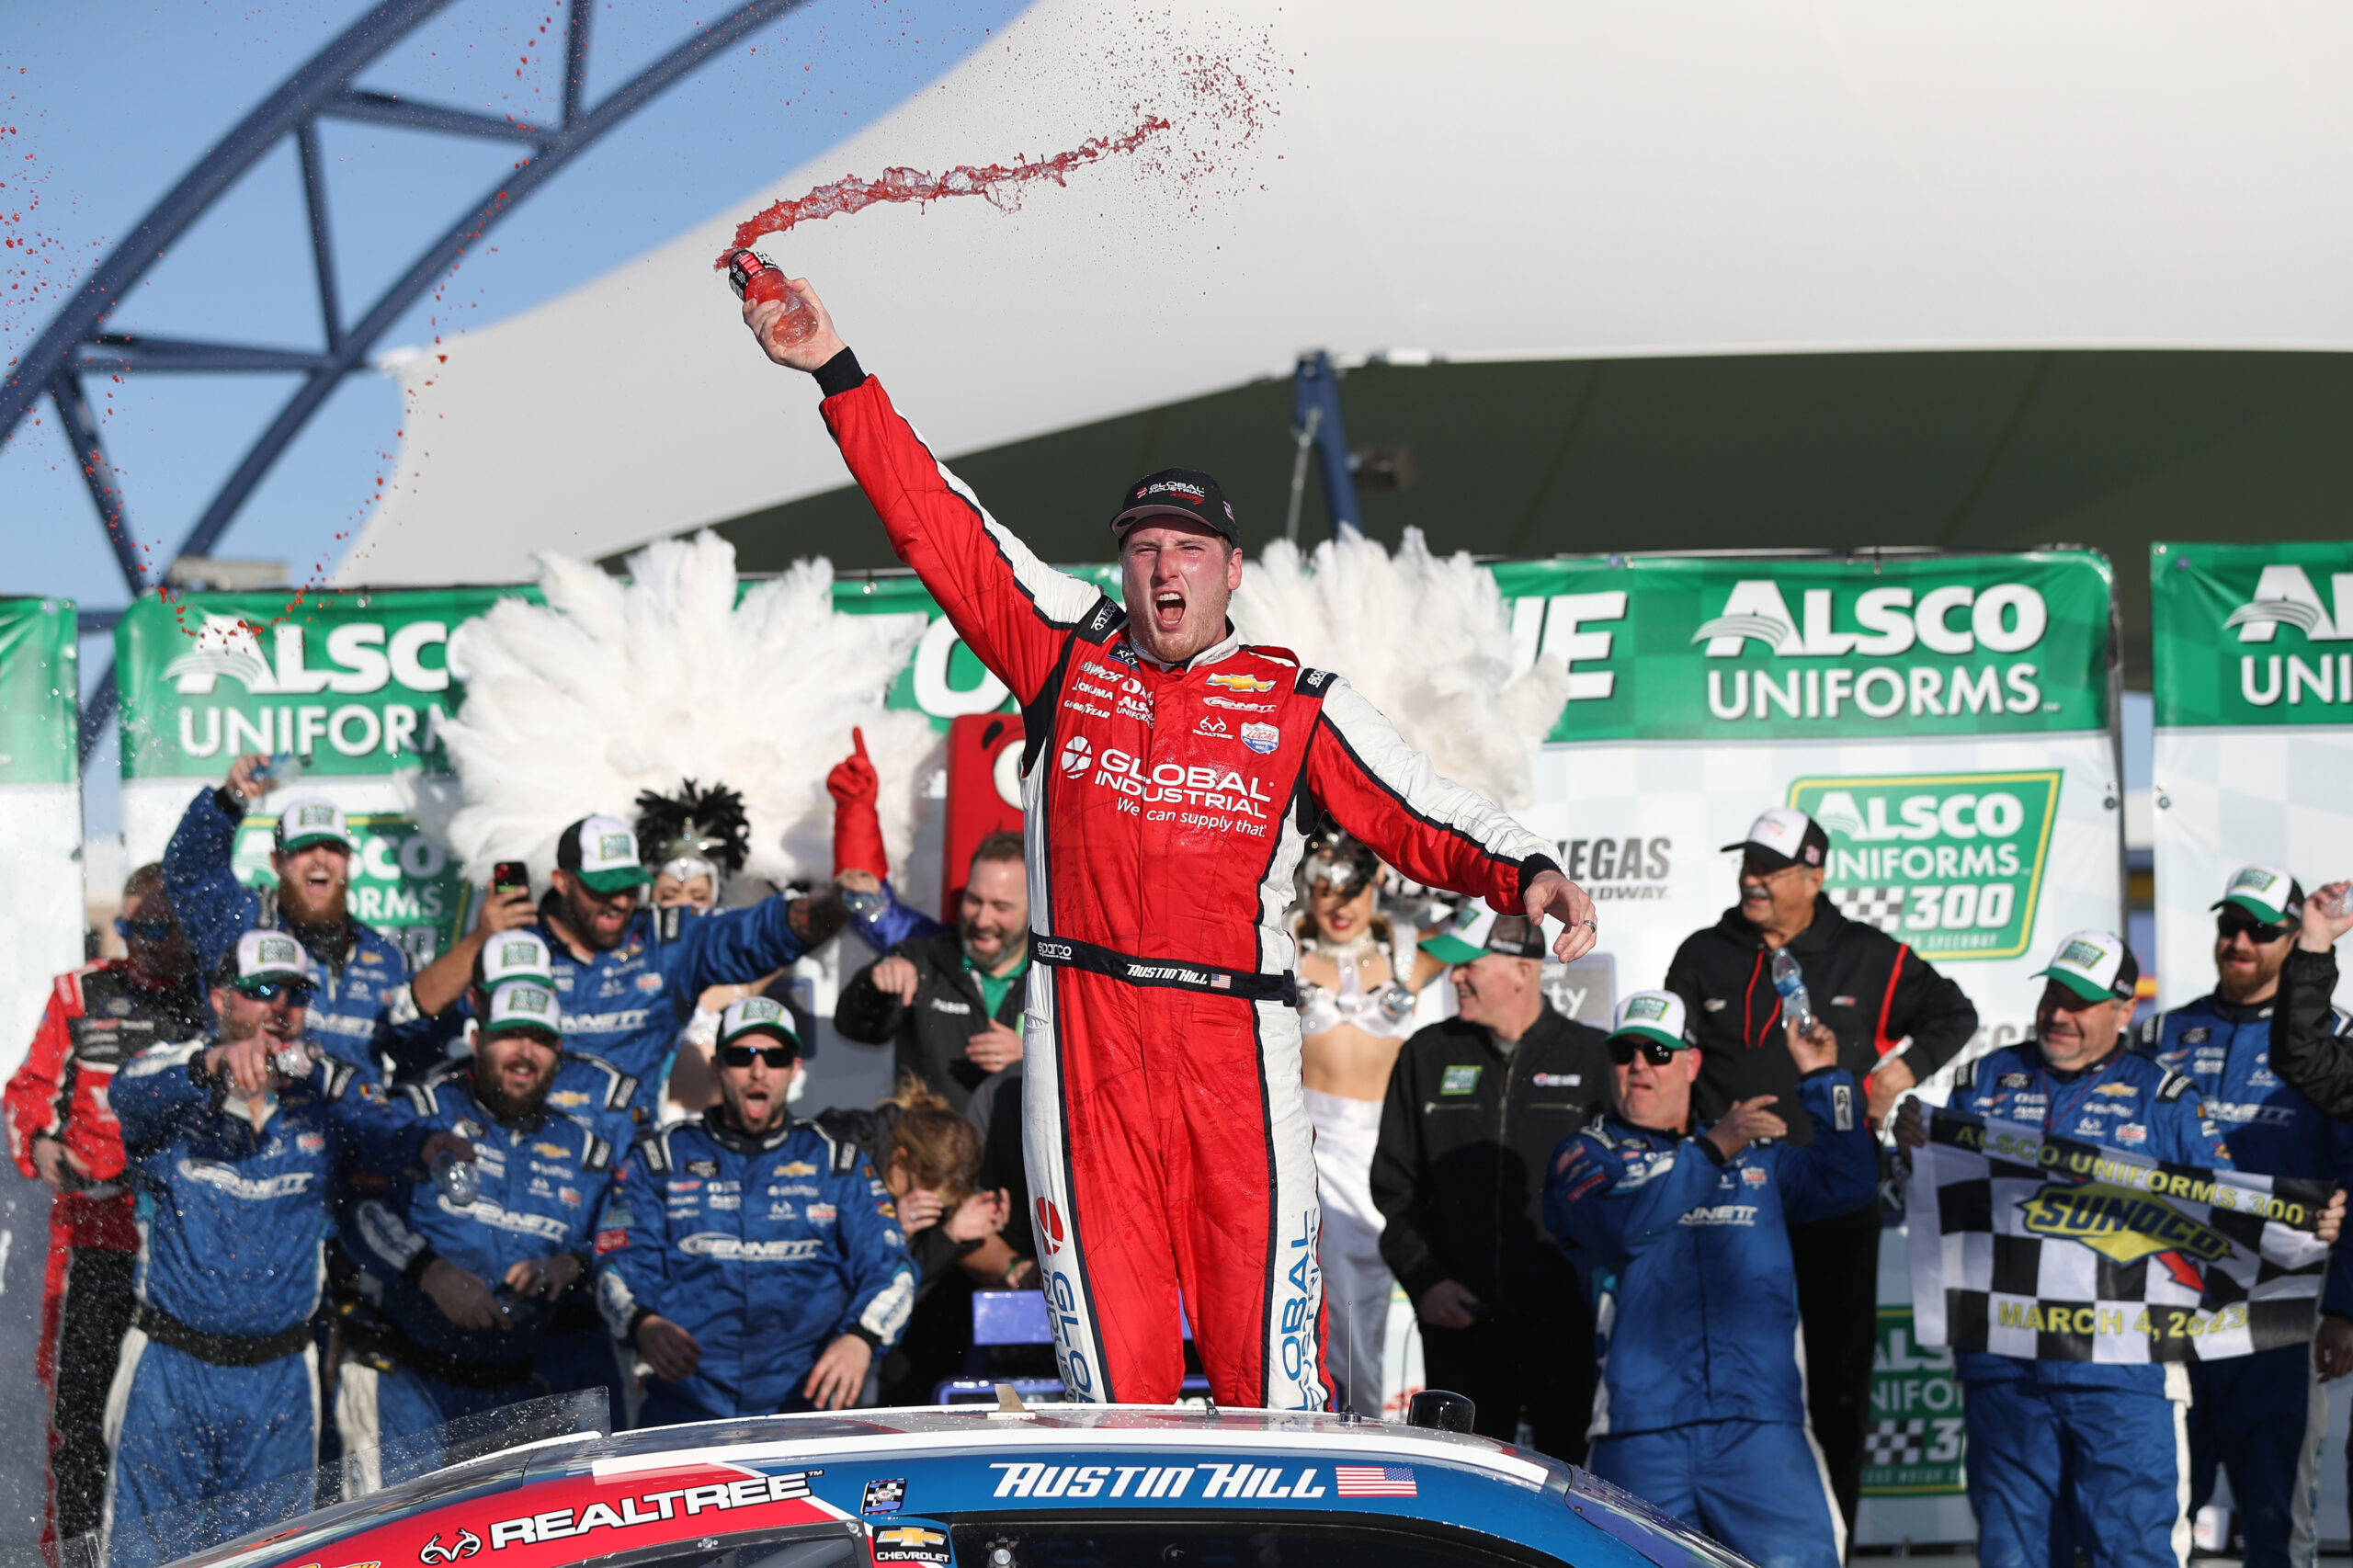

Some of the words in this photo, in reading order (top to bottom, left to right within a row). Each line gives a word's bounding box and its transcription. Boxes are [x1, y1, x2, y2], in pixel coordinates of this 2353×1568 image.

[1150, 481, 1204, 494] GLOBAL
[1692, 580, 2047, 656] ALSCO
[1210, 699, 1278, 711] BENNETT
[1708, 663, 2040, 720] UNIFORMS
[1192, 729, 1234, 739] REALTREE
[1246, 731, 1277, 740] LUCAS
[1100, 748, 1272, 802] GLOBAL
[1094, 770, 1267, 819] INDUSTRIAL
[1117, 797, 1141, 816] We
[1146, 810, 1176, 822] can
[1180, 811, 1233, 832] supply
[1816, 791, 2024, 841] ALSCO
[1905, 882, 2015, 930] 300
[1038, 941, 1072, 958] sparco
[1127, 963, 1176, 980] AUSTIN
[1175, 968, 1208, 985] HILL
[1955, 1126, 2060, 1165] ALSCO
[2069, 1150, 2236, 1210] UNIFORMS
[2247, 1193, 2305, 1225] 300
[2029, 1191, 2229, 1260] SUNOCO
[695, 1238, 824, 1256] BENNETT
[1998, 1302, 2122, 1335] MARCH
[2135, 1311, 2162, 1342] 4,
[2167, 1306, 2248, 1338] 2023
[989, 1462, 1199, 1498] AUSTIN
[1196, 1462, 1327, 1498] HILL
[491, 1472, 812, 1550] REALTREE
[877, 1551, 949, 1562] CHEVROLET
